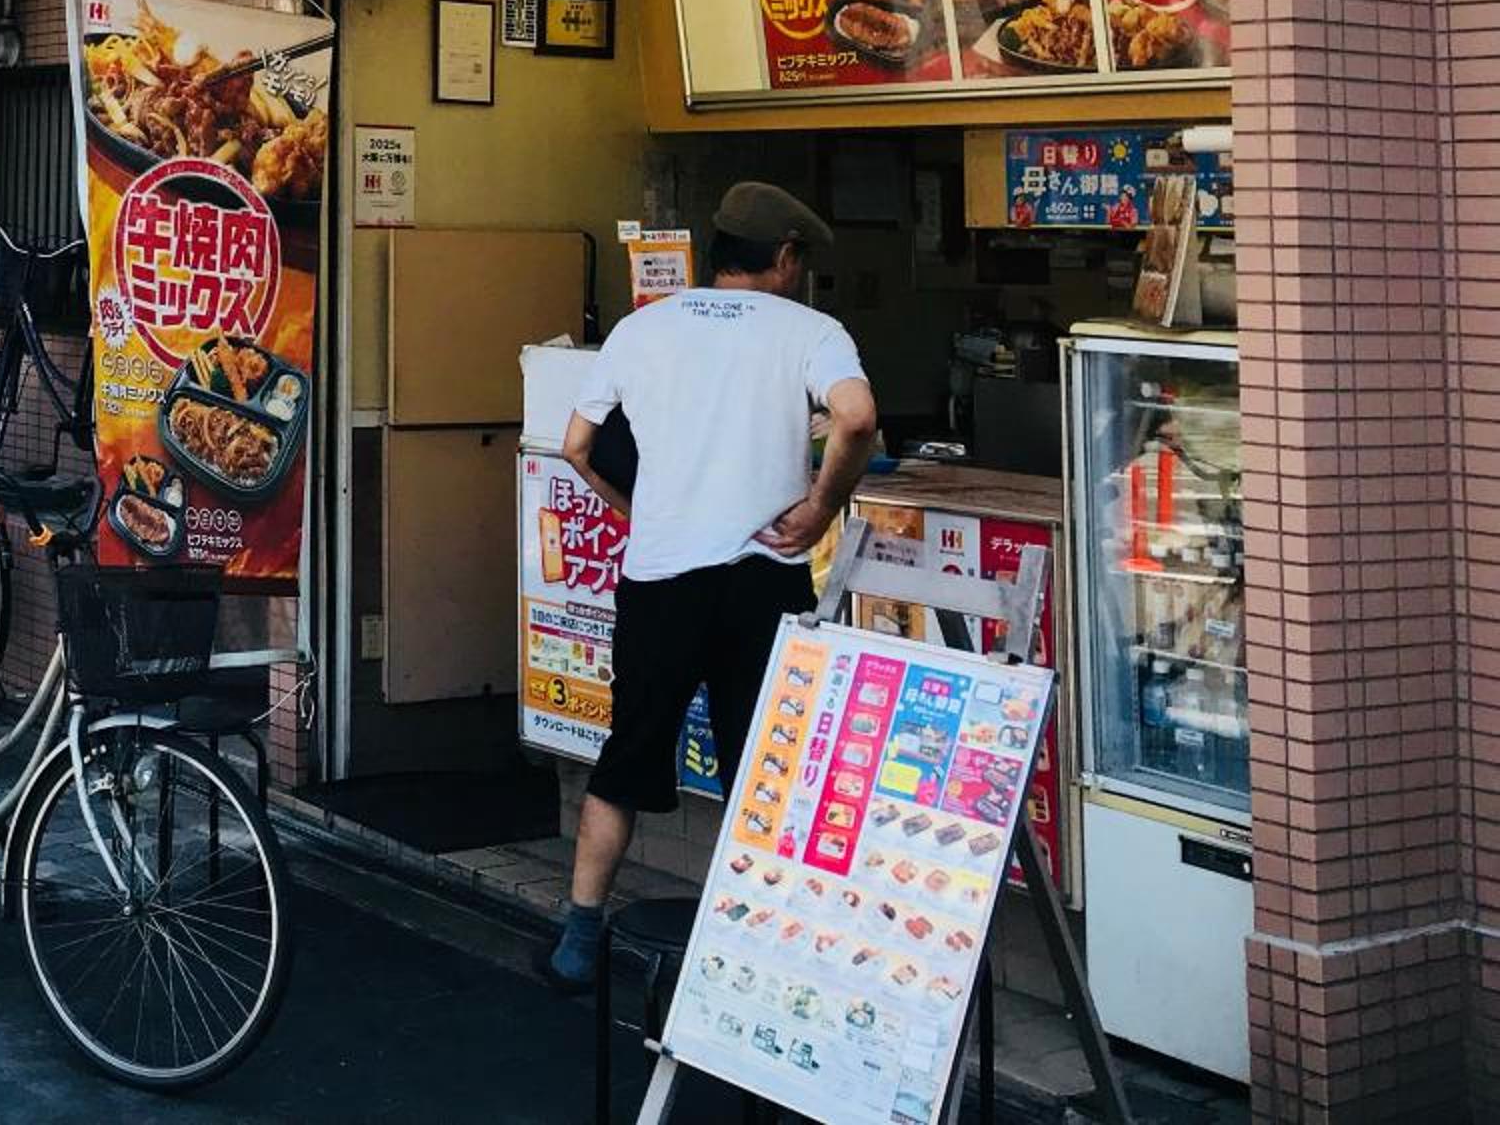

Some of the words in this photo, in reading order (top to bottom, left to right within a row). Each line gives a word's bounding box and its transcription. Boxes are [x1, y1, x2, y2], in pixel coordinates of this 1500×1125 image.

[1042, 144, 1098, 167] 日替り
[123, 193, 270, 280] 牛焼肉
[129, 263, 258, 335] ミックス
